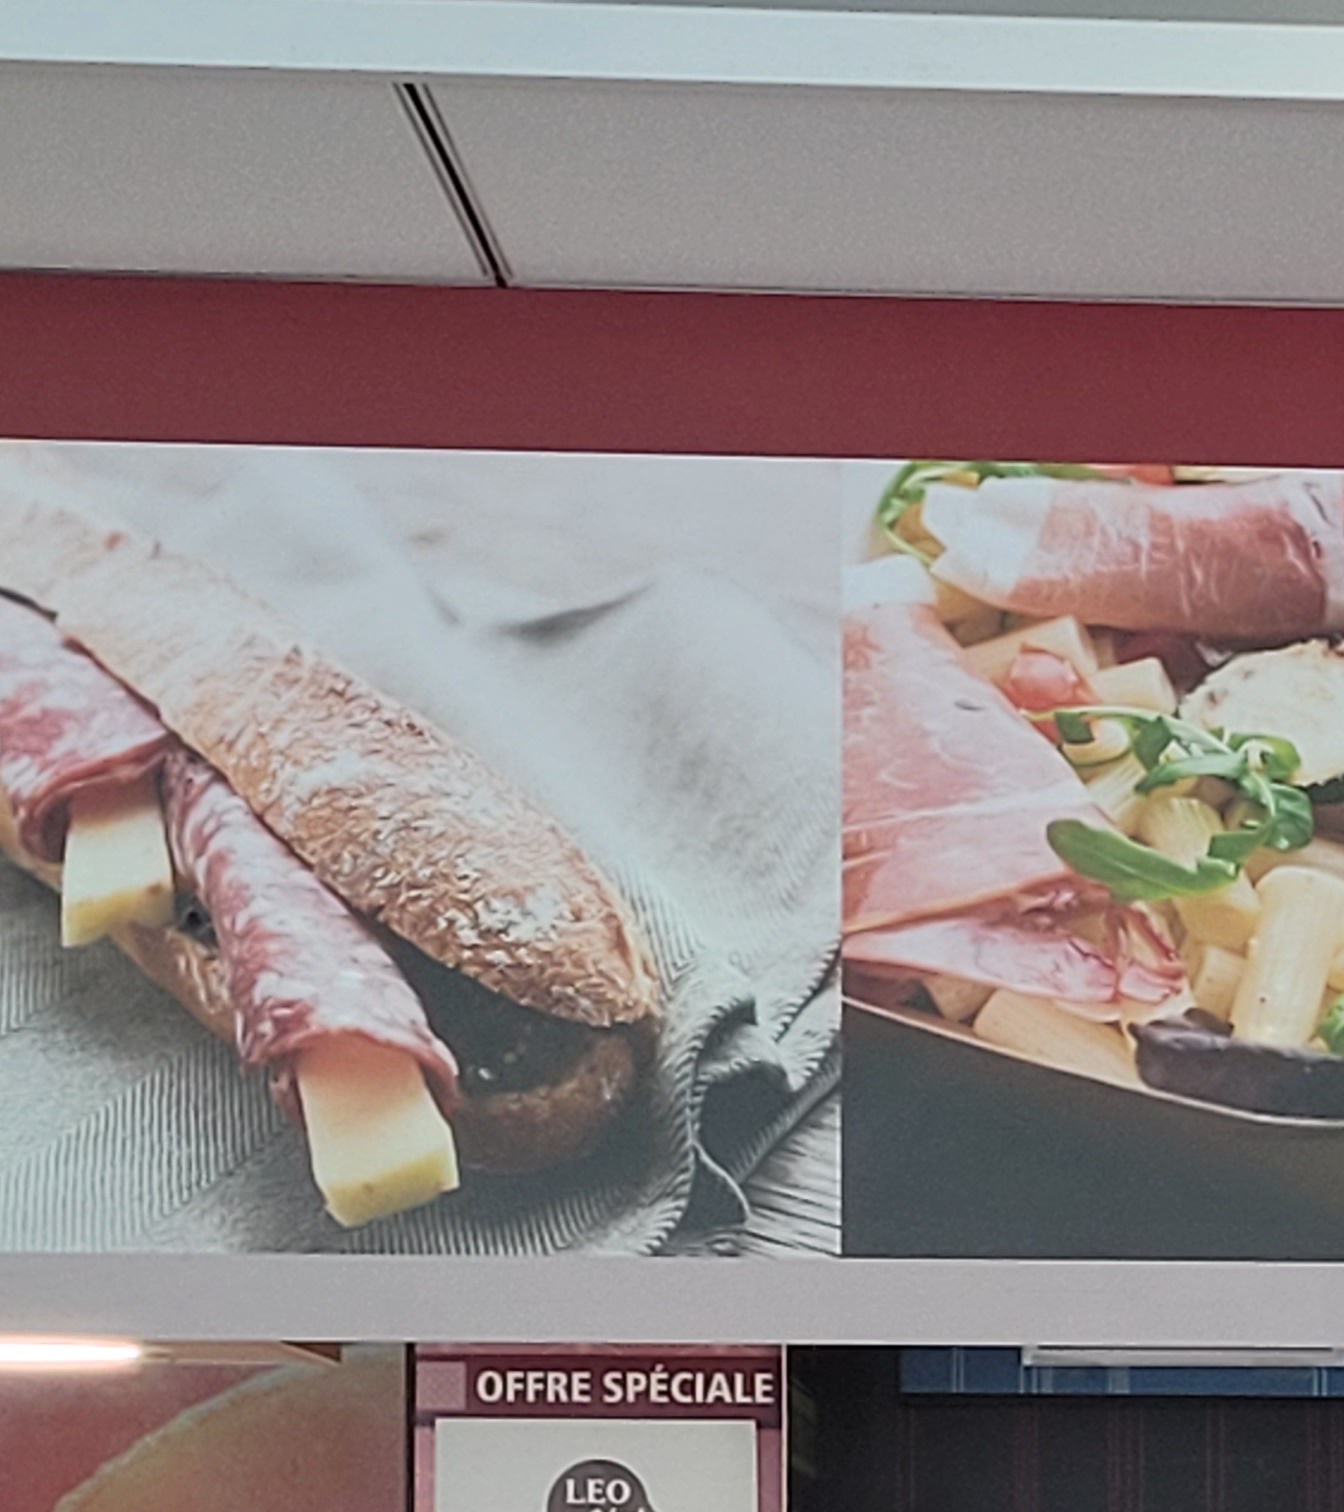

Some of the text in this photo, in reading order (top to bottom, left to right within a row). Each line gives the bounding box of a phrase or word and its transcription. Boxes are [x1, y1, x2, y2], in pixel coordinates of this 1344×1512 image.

[476, 1363, 776, 1404] OFFRE SPÉCIALE
[565, 1478, 632, 1505] LEO
